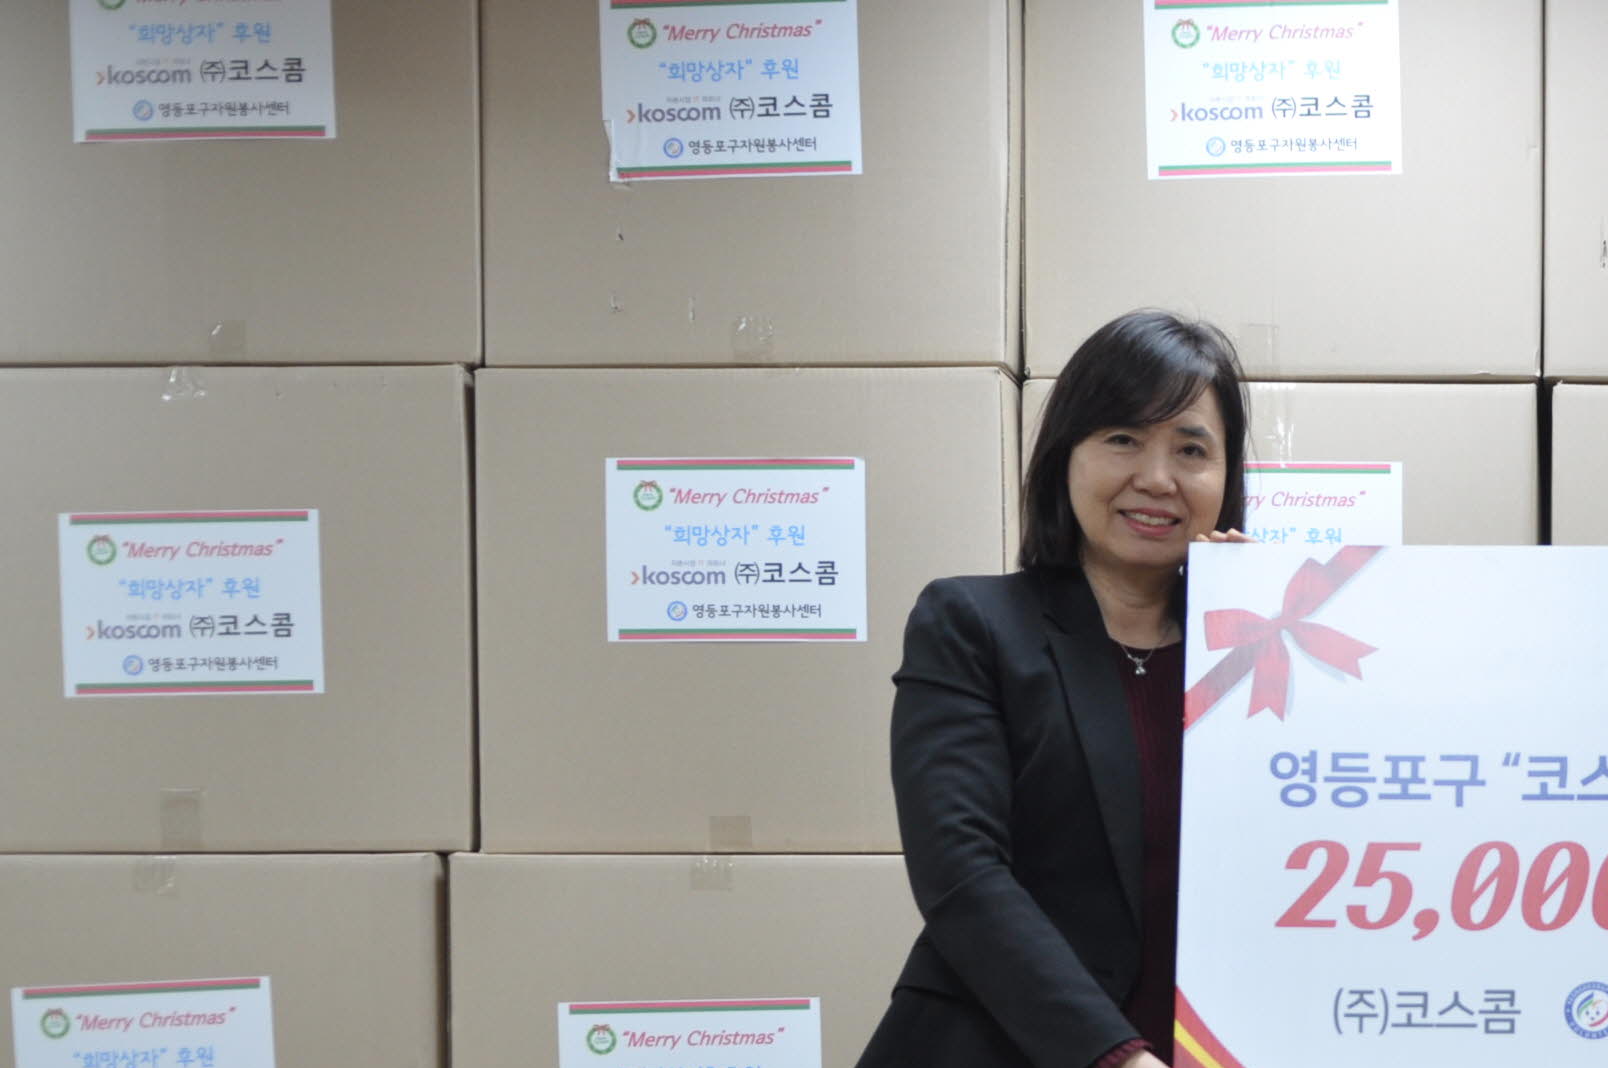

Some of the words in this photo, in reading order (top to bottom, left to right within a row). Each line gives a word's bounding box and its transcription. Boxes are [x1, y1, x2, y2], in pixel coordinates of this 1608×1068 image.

[232, 23, 273, 43] 후원
[107, 64, 192, 85] koscom
[760, 59, 799, 80] 후원
[1303, 60, 1342, 80] 후원
[638, 103, 721, 123] koscom
[1181, 102, 1263, 122] koscom
[688, 136, 817, 155] 영등포구자원봉사센터
[1231, 137, 1358, 154] 영등포구자원봉사센터
[767, 524, 806, 547] 후원
[642, 565, 726, 585] koscom
[221, 576, 261, 599] 후원
[692, 603, 822, 619] 영등포구자원봉사센터
[97, 620, 182, 640] koscom
[148, 655, 278, 673] 영등포구자원봉사센터
[1269, 750, 1486, 808] 영등포구
[1333, 987, 1522, 1035] (주)코스콤
[176, 1044, 215, 1068] 후원
